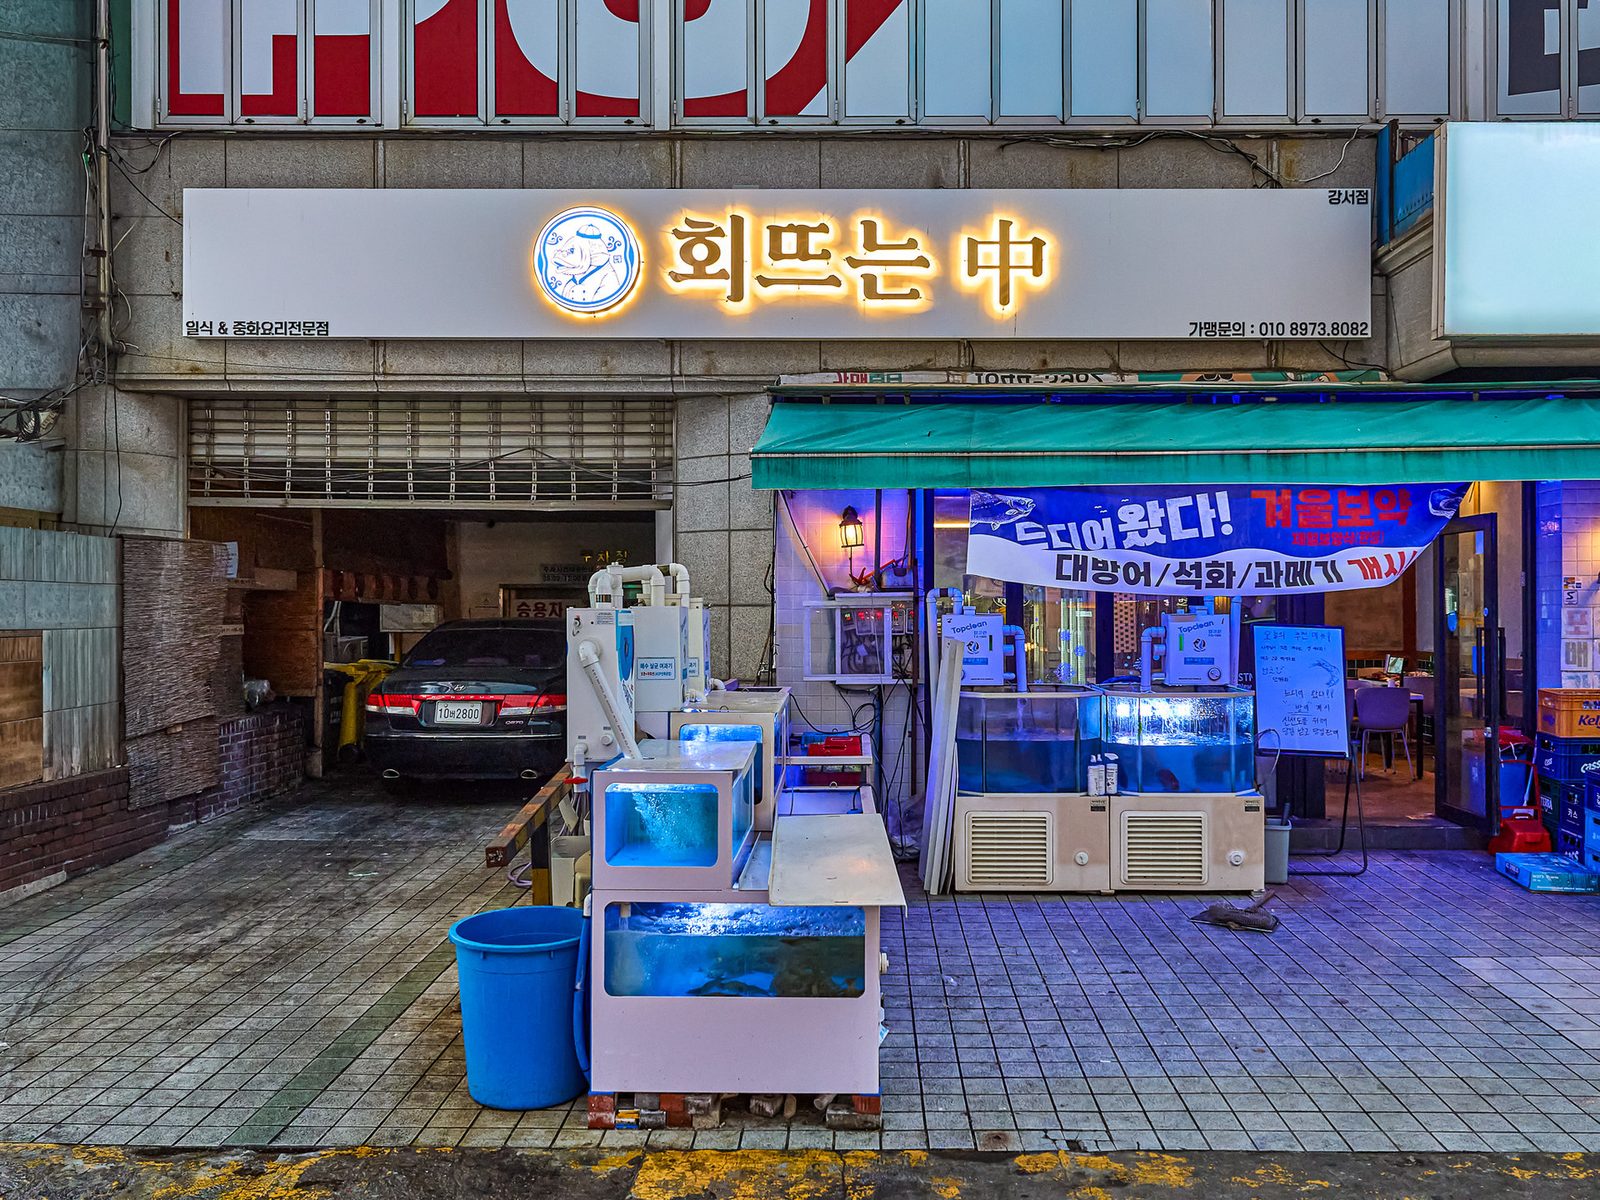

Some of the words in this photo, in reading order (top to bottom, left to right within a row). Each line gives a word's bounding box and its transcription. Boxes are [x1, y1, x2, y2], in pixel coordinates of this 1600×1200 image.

[1328, 190, 1368, 205] 강서점
[667, 213, 931, 303] 회뜨는
[967, 219, 1046, 306] 中
[185, 320, 213, 336] 일식
[218, 321, 228, 335] &
[232, 320, 330, 336] 중화요리전문점
[1188, 321, 1246, 337] 가맹문의
[1259, 322, 1285, 336] 010
[1290, 322, 1369, 336] 8973.8082
[1250, 488, 1413, 528] 겨울보약
[1015, 518, 1117, 551] 드디어
[1117, 490, 1234, 549] 왔다!
[516, 601, 563, 618] 승용차
[951, 620, 988, 634] Topclean
[1177, 620, 1215, 634] Topclean
[438, 707, 480, 720] 10버2800
